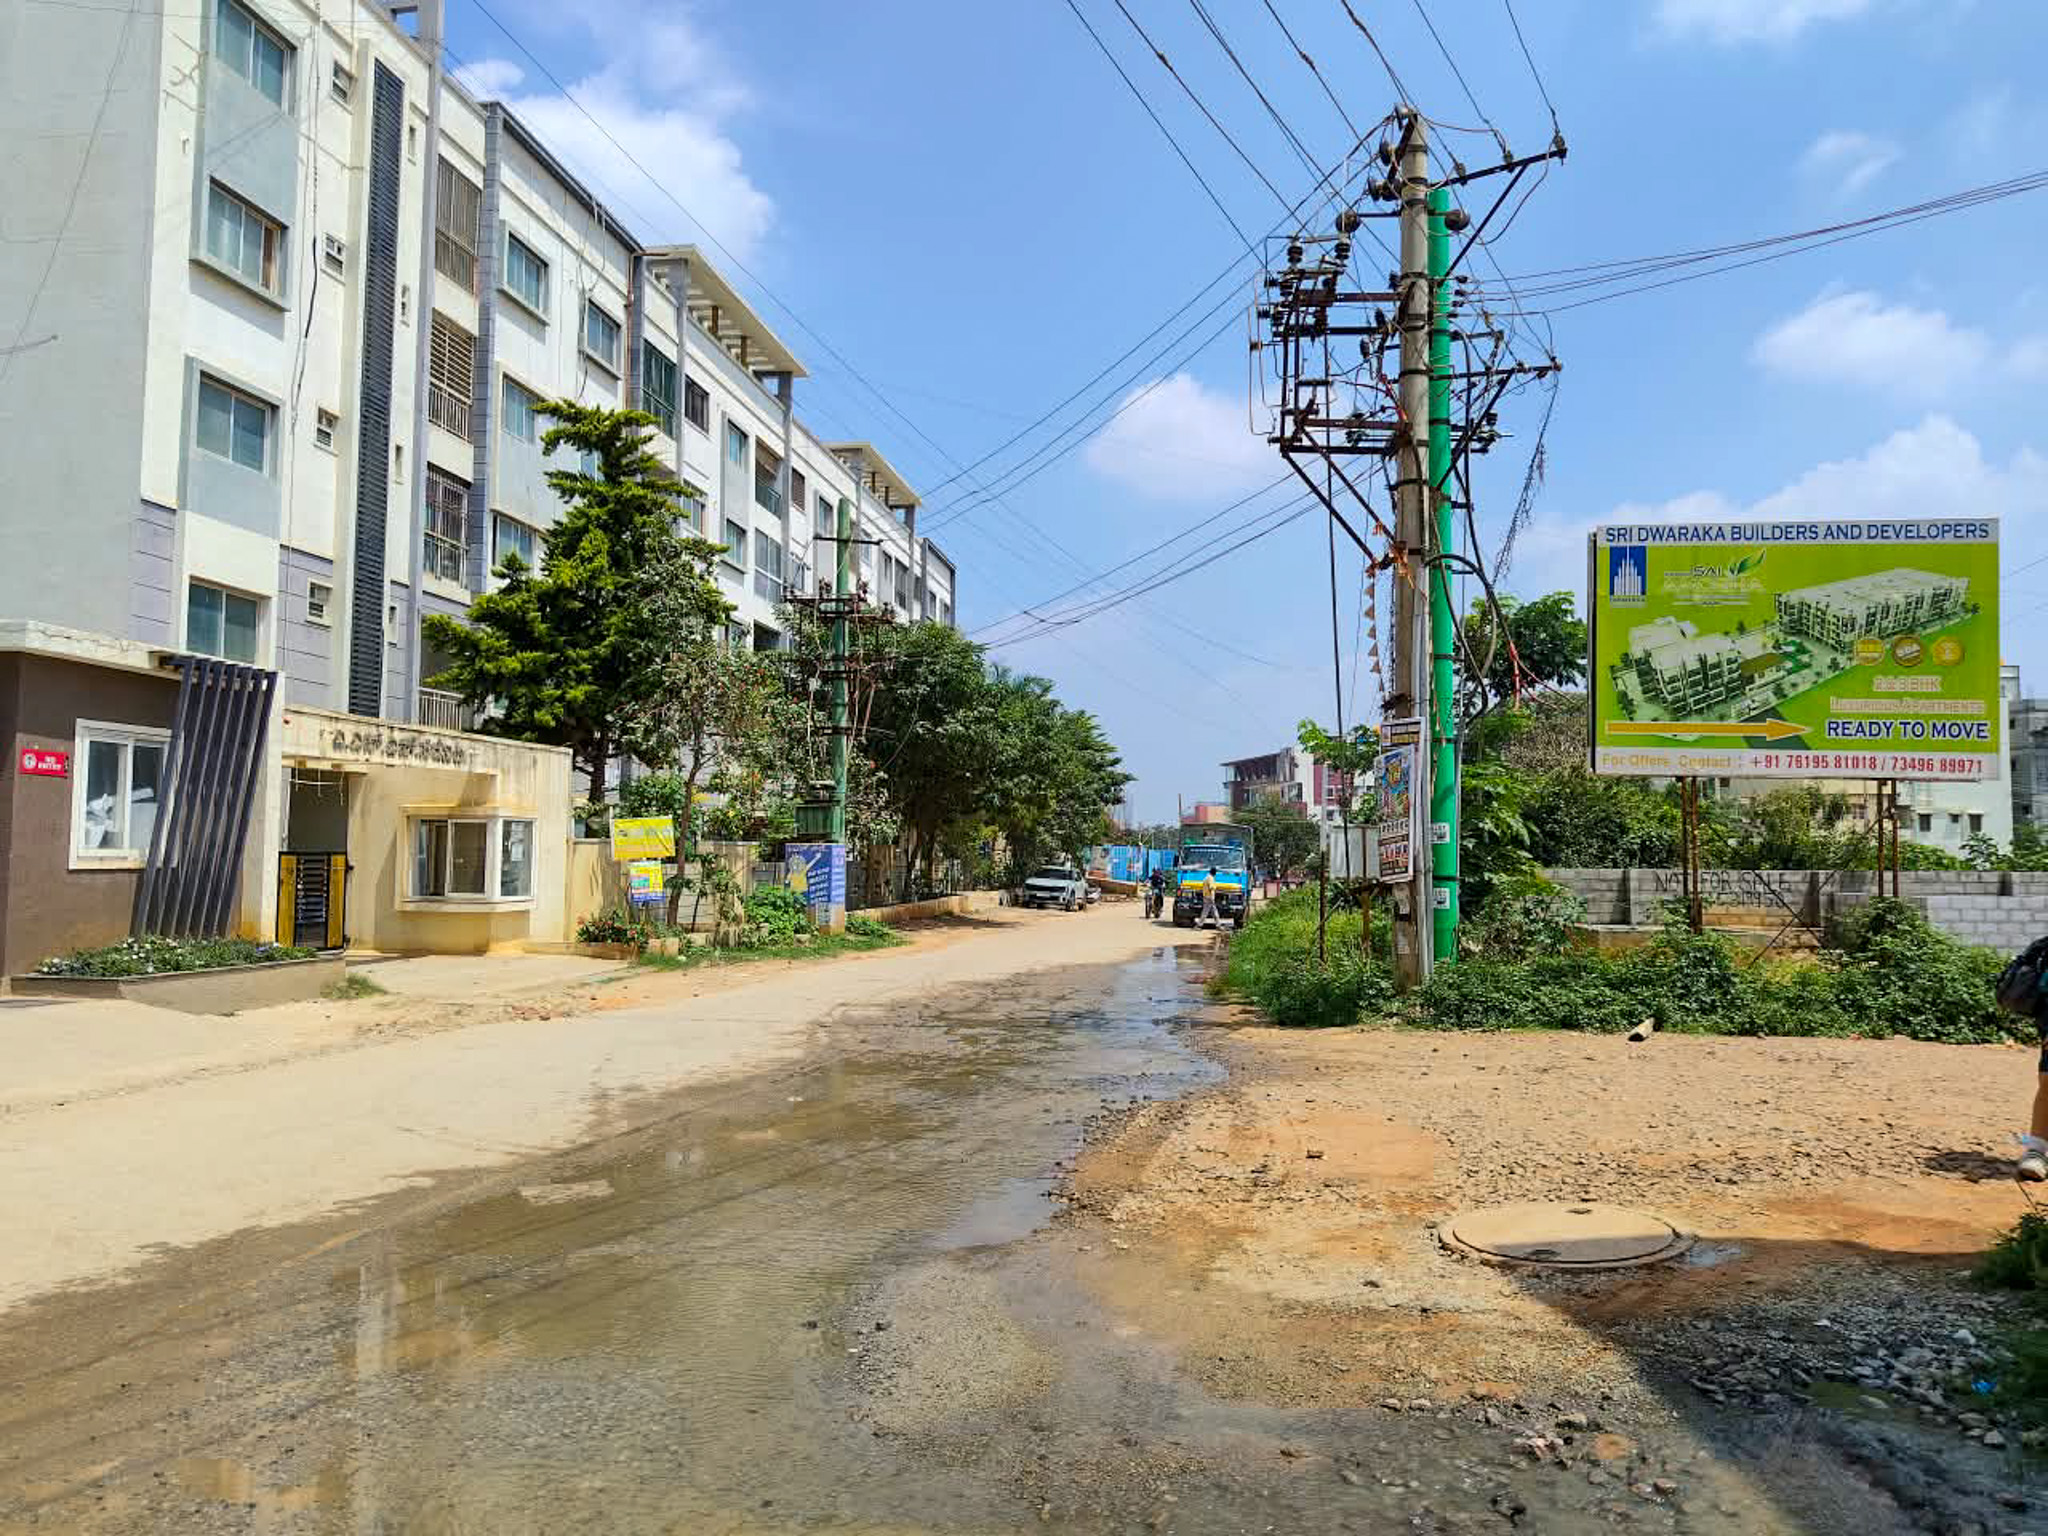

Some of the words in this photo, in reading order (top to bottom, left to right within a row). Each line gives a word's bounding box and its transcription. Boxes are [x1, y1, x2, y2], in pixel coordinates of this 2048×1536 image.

[1606, 526, 1633, 542] SRI
[1637, 525, 1726, 542] DWARAKA
[1731, 524, 1819, 541] BUILDERS
[1823, 524, 1862, 540] AND
[1866, 522, 1990, 539] DEVELOPERS
[1827, 720, 1894, 738] READY
[1899, 721, 1926, 738] TO
[1931, 722, 1989, 739] MOVE
[1833, 755, 1878, 769] 81018
[1891, 756, 1934, 772] 73496
[1700, 871, 1732, 892] FOR
